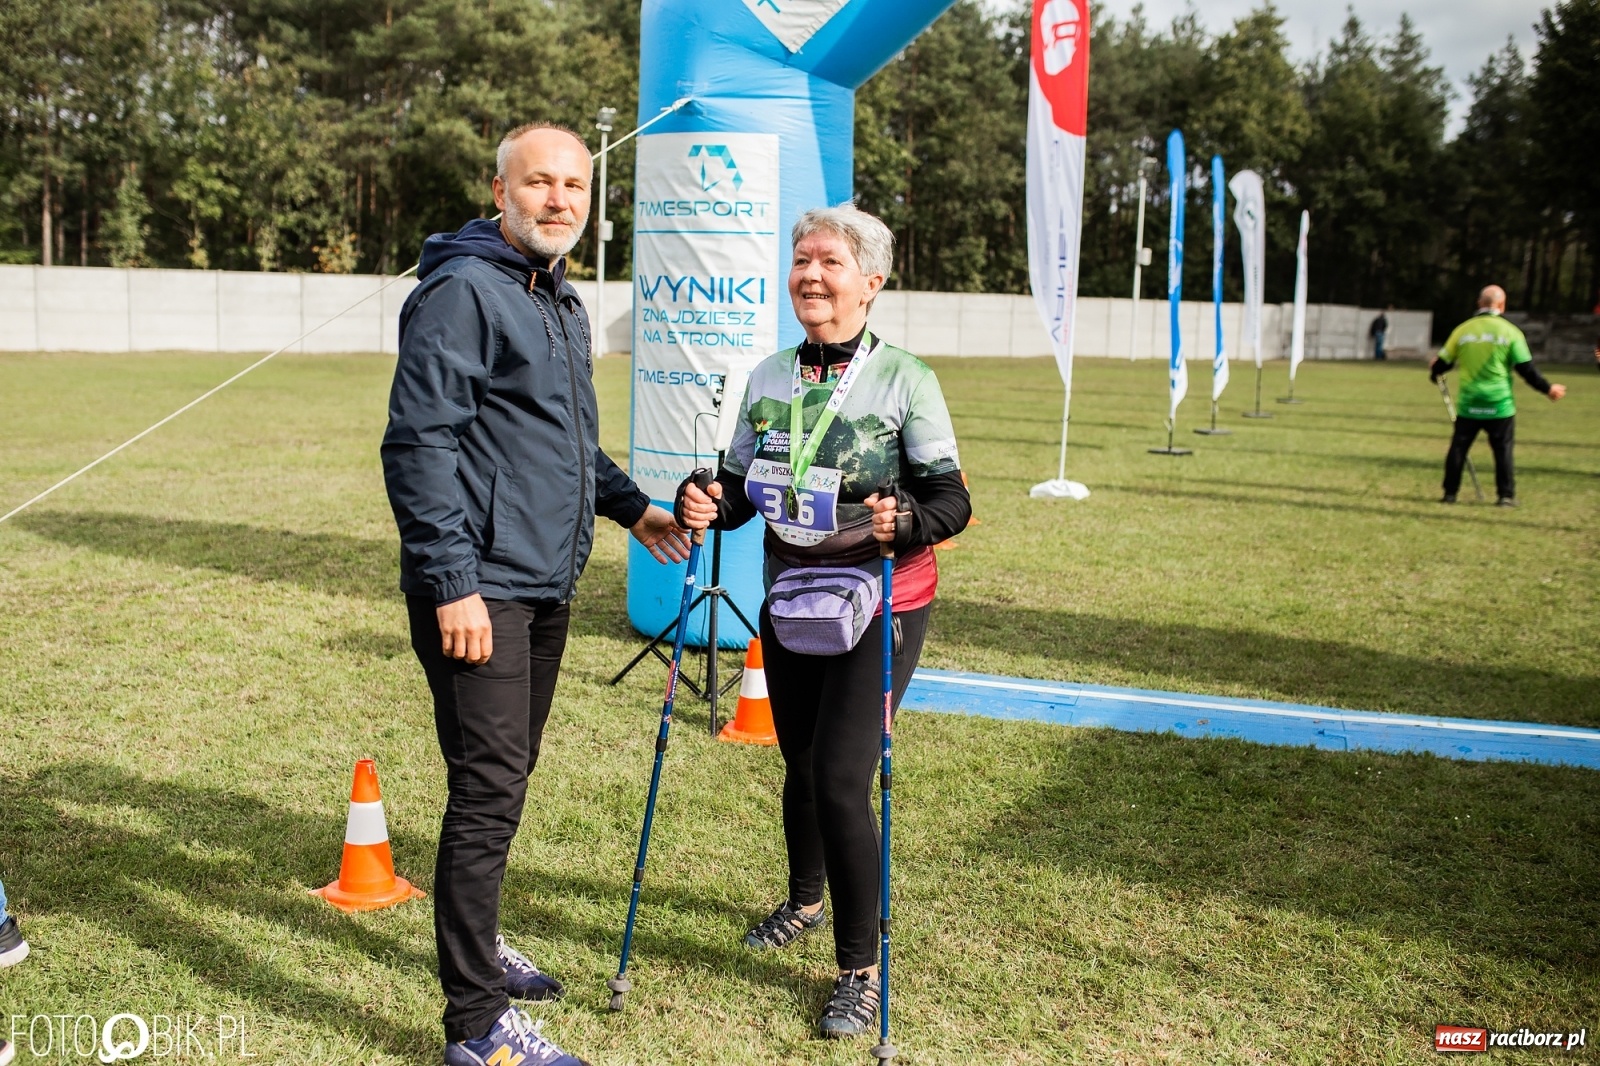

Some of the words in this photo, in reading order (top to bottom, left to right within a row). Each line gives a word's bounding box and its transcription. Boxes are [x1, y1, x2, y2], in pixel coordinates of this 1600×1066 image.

[638, 201, 770, 217] TIMESPORT
[639, 275, 765, 304] WYNIKI
[643, 308, 756, 326] ZNAJDZIESZ
[643, 331, 662, 343] NA
[667, 331, 753, 347] STRONIE
[638, 369, 722, 387] TIME-SPOR
[635, 466, 690, 481] WWW.TIME
[763, 487, 814, 526] 36
